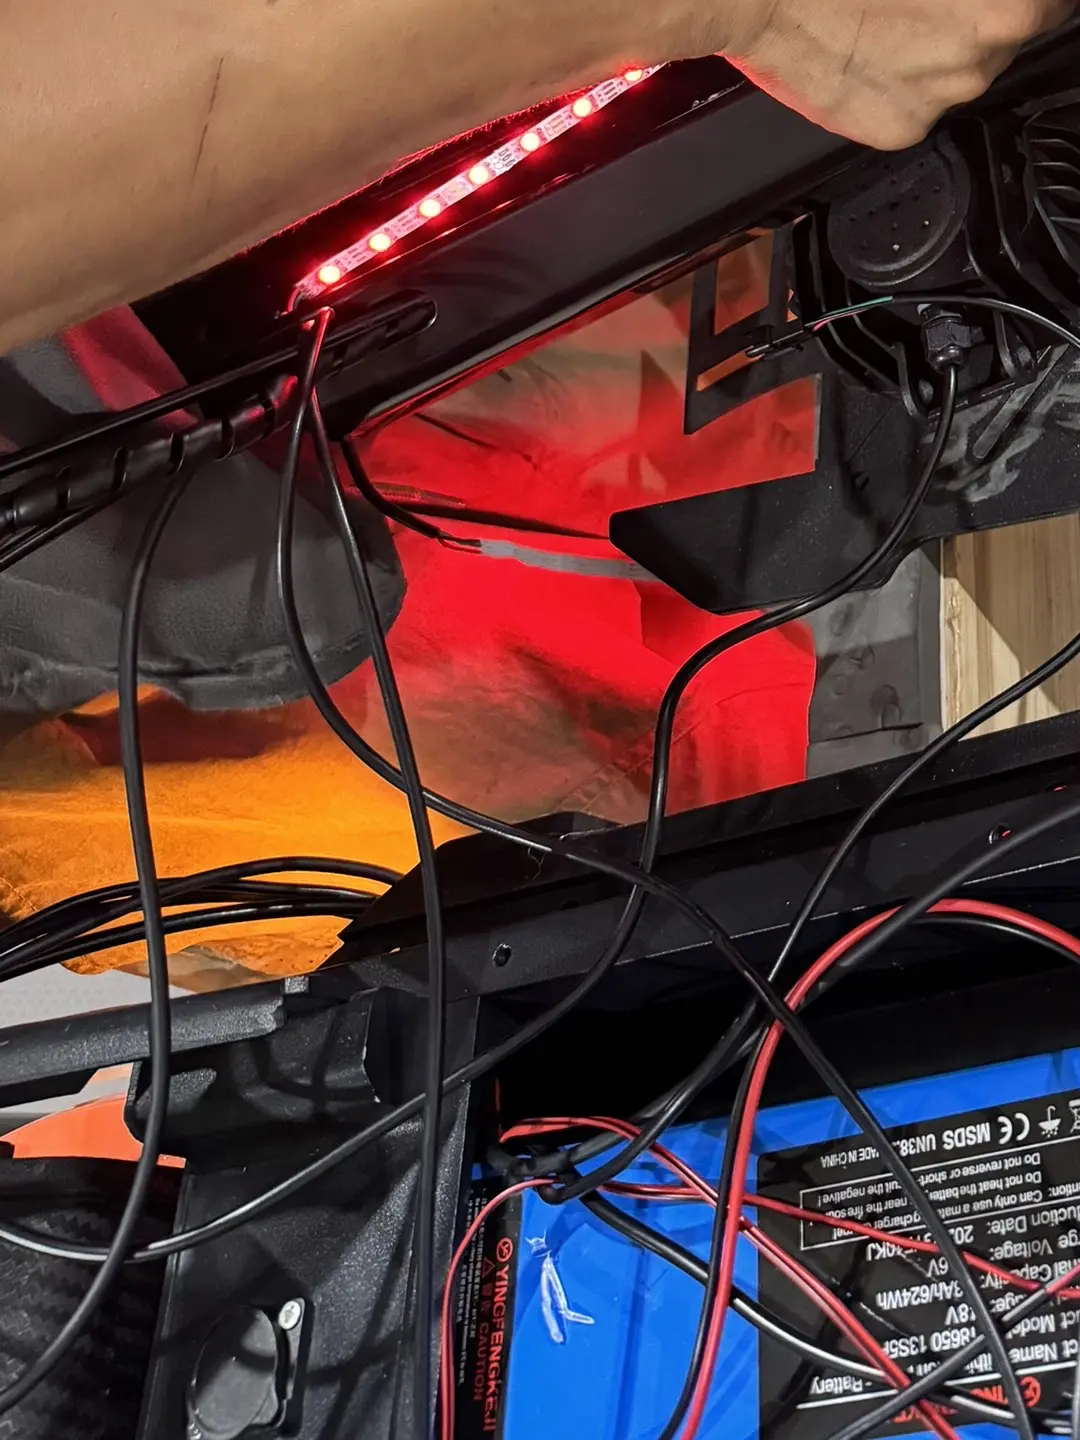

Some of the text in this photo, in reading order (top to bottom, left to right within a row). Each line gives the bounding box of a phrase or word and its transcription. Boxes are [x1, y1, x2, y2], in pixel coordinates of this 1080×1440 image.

[940, 1121, 992, 1150] MSDS
[887, 1133, 937, 1158] UN38.
[819, 1151, 847, 1169] CHINA
[846, 1149, 858, 1163] IN
[1003, 1155, 1022, 1169] not
[1023, 1151, 1041, 1165] Do
[948, 1168, 961, 1178] or
[961, 1159, 1002, 1175] reverse
[1003, 1174, 1023, 1188] not
[1024, 1170, 1042, 1184] Do
[866, 1182, 884, 1196] the
[959, 1183, 976, 1196] the
[977, 1177, 1003, 1193] heat
[816, 1184, 866, 1206] negative!
[993, 1191, 1017, 1209] only
[1019, 1189, 1042, 1204] Can
[865, 1201, 882, 1214] the
[882, 1196, 907, 1210] near
[962, 1202, 970, 1213] a
[972, 1198, 993, 1211] use
[846, 1205, 864, 1220] fire
[985, 1215, 1027, 1237] Date:
[987, 1236, 1052, 1262] Voltage:
[978, 1261, 1052, 1288] Capity:
[874, 1278, 964, 1310] 3Ah/624Wh
[473, 1322, 490, 1401] CAUTION
